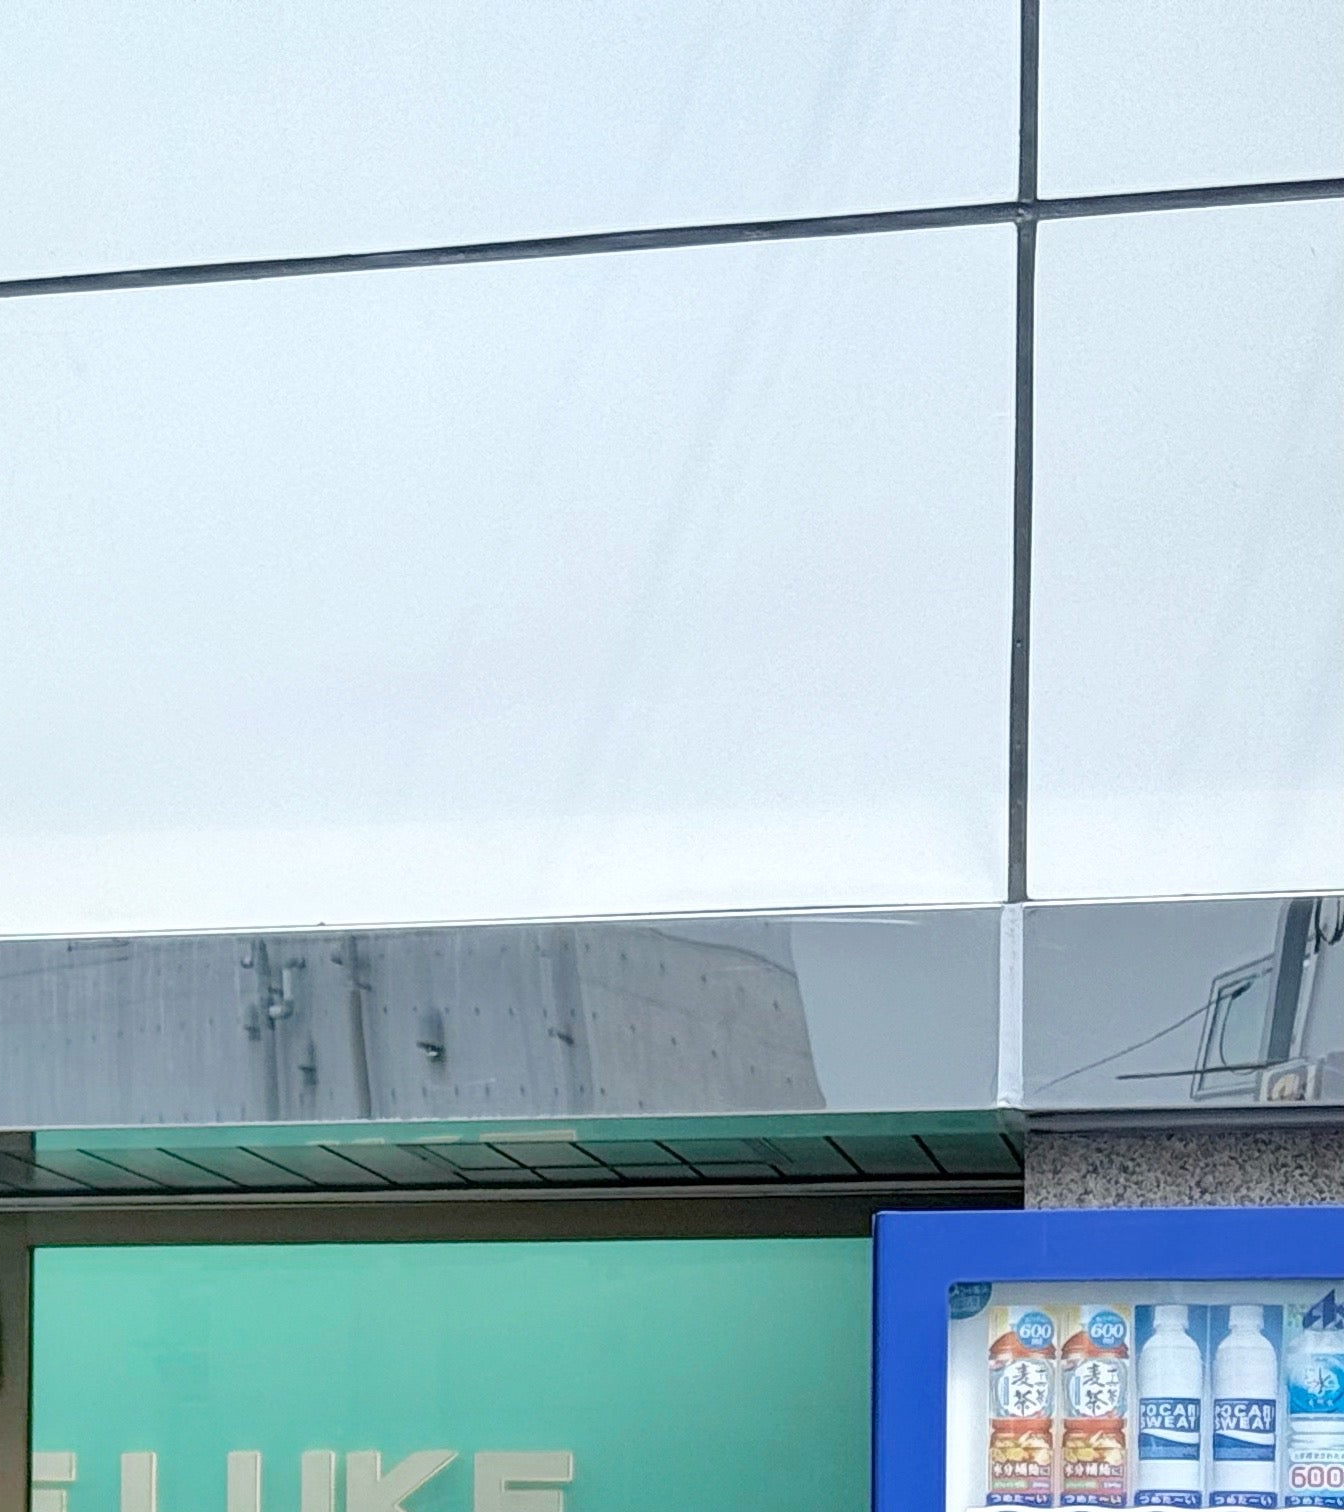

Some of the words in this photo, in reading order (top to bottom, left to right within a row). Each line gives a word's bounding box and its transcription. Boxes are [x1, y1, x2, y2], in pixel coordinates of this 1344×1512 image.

[1020, 1323, 1051, 1339] 600
[1091, 1323, 1124, 1339] 600
[1011, 1362, 1037, 1417] 麦茶
[1083, 1362, 1108, 1417] 麦茶
